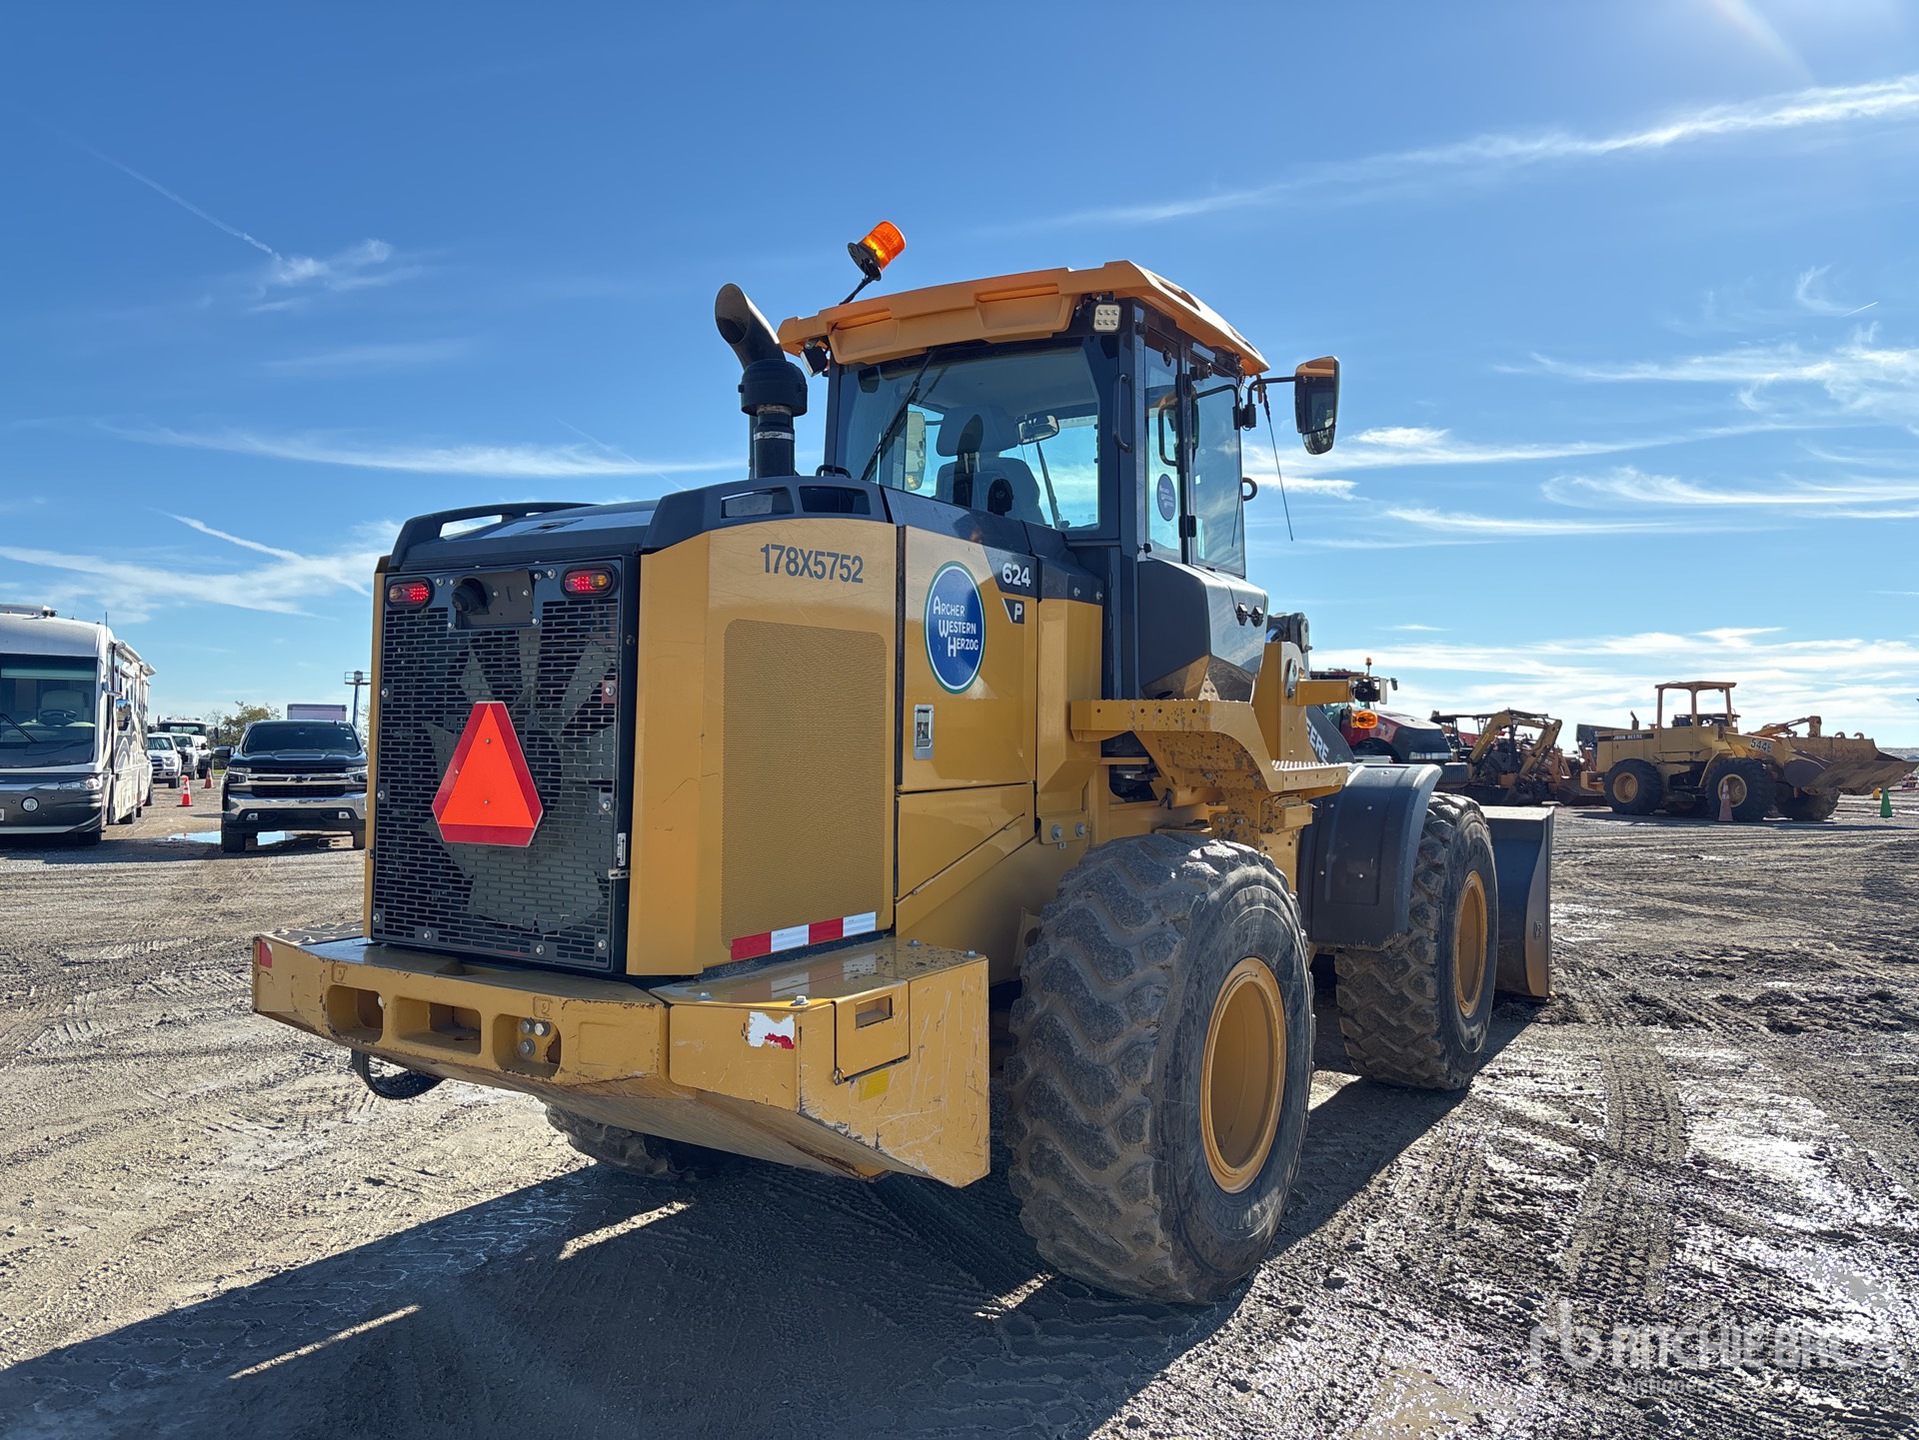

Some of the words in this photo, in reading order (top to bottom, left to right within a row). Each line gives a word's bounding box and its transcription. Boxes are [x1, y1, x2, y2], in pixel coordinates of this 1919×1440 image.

[760, 543, 864, 584] 178X5752
[1002, 562, 1031, 588] 624
[933, 595, 966, 617] ARCHER
[1013, 602, 1024, 621] P
[938, 619, 977, 638] WESTERN
[947, 636, 979, 657] HERZOG
